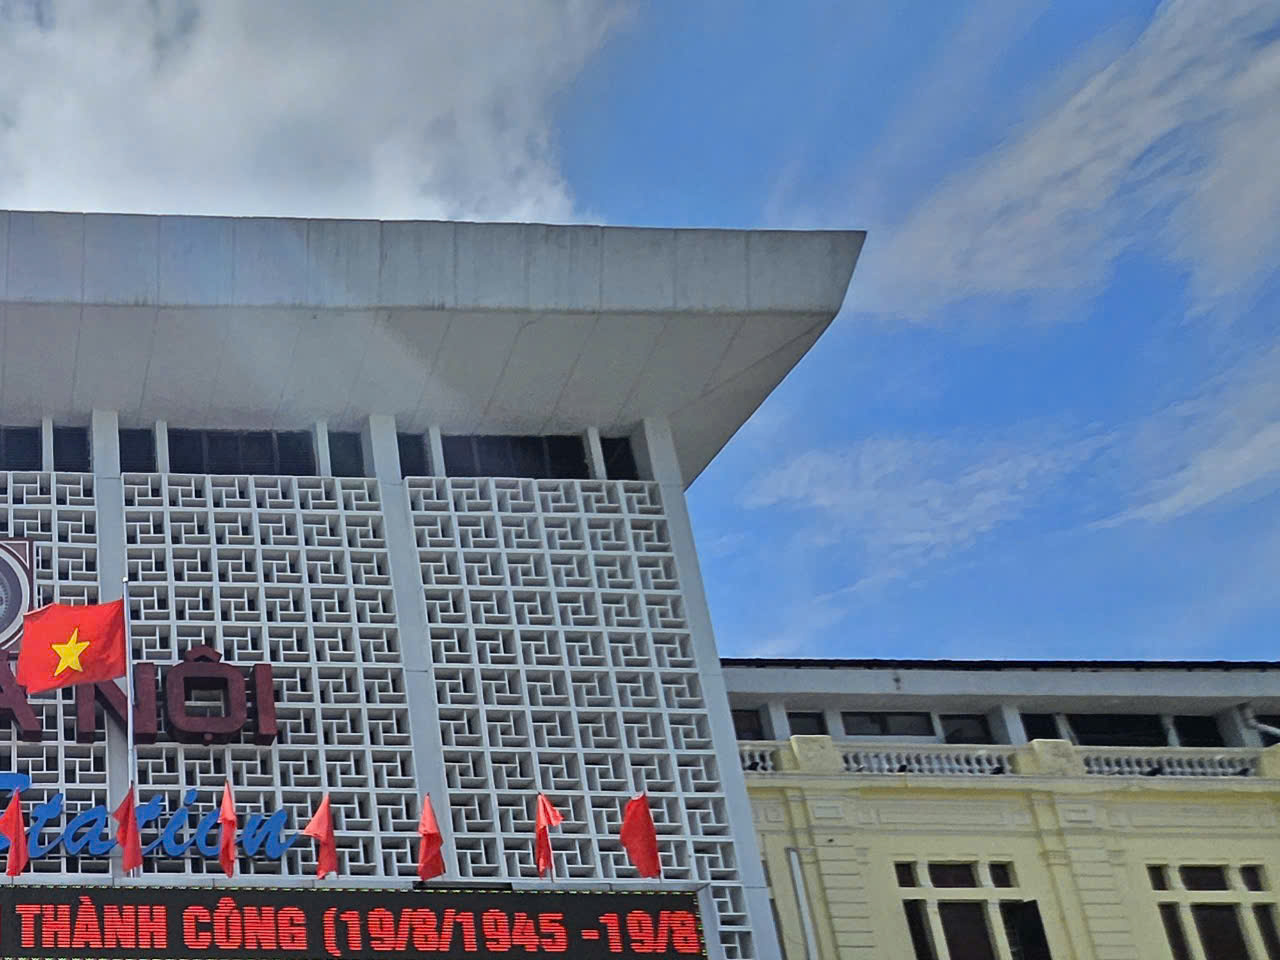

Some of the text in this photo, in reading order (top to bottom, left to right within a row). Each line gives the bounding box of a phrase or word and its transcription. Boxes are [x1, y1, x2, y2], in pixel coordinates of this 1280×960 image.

[77, 645, 278, 744] NỘI
[15, 896, 167, 949] THÀNH
[182, 896, 308, 950] CÔNG
